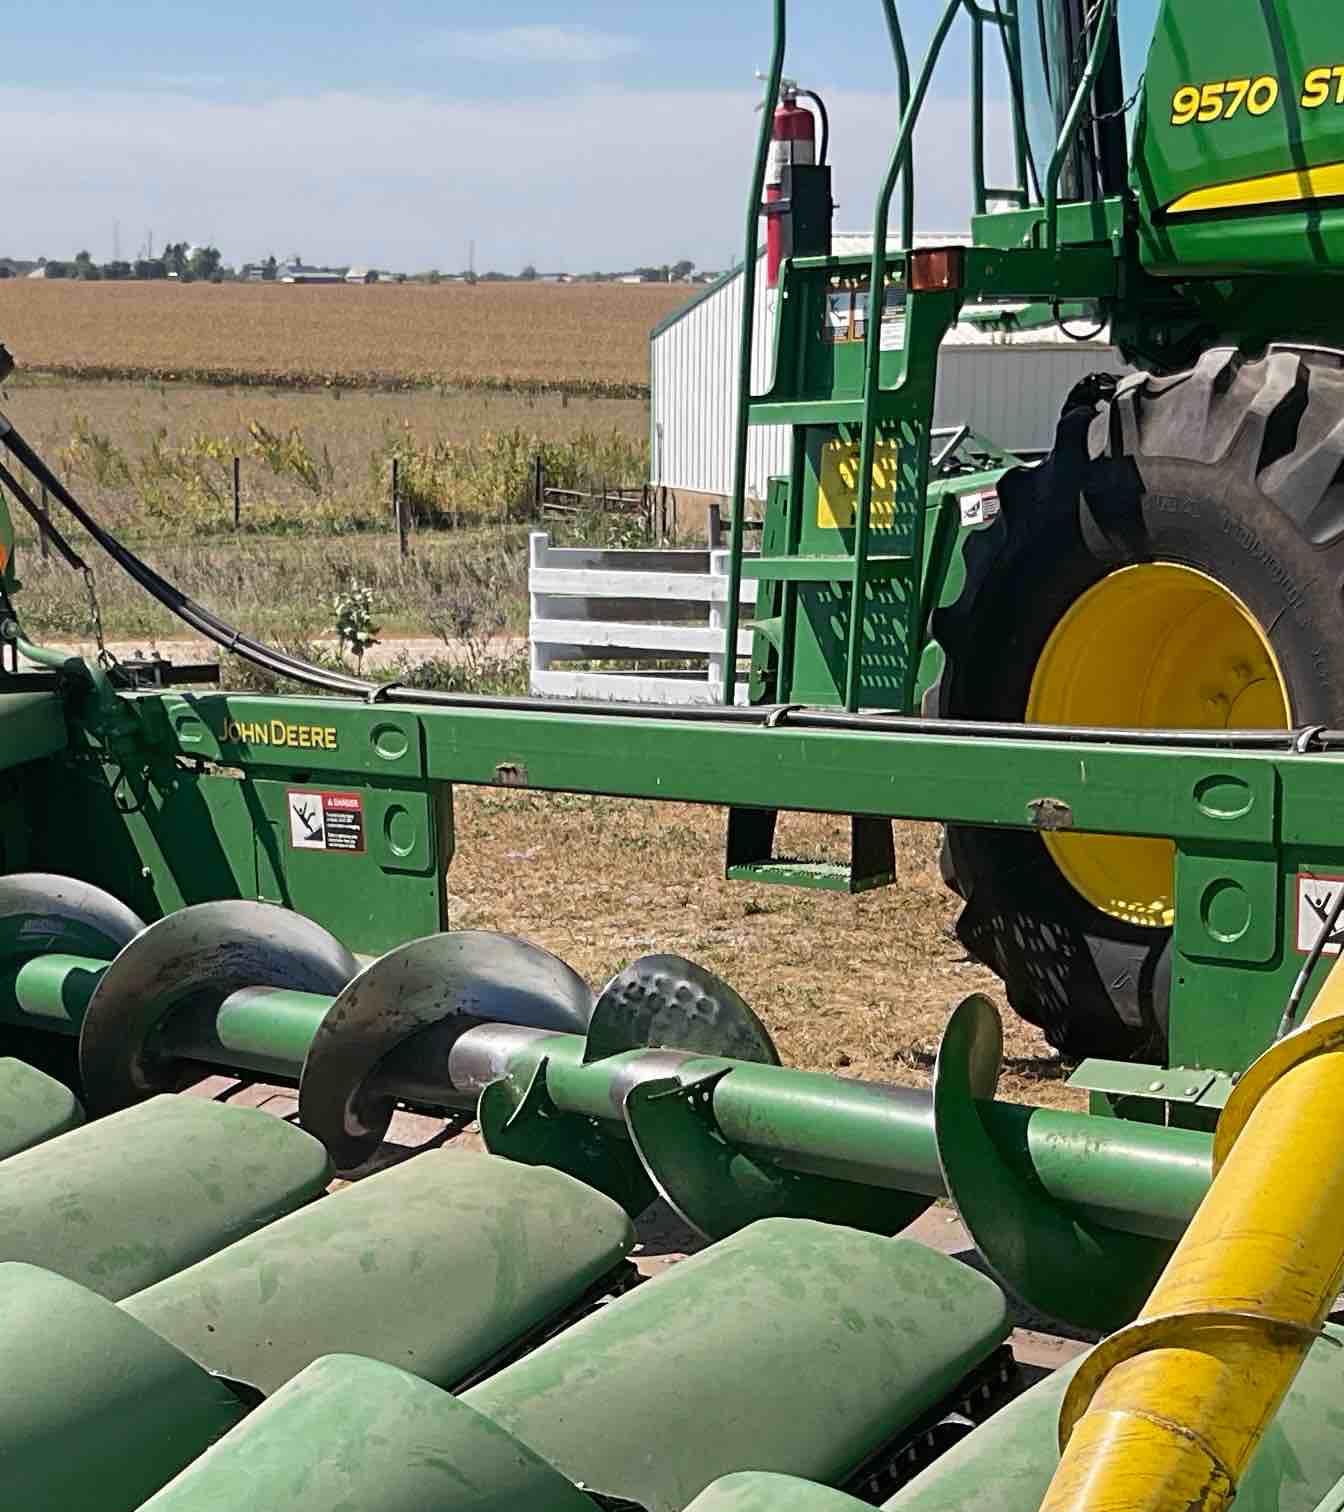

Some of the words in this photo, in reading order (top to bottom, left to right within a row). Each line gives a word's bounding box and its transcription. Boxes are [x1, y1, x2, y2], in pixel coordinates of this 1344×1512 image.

[1171, 76, 1279, 126] 9570
[219, 718, 269, 744] JOHN
[271, 719, 337, 749] DEERE
